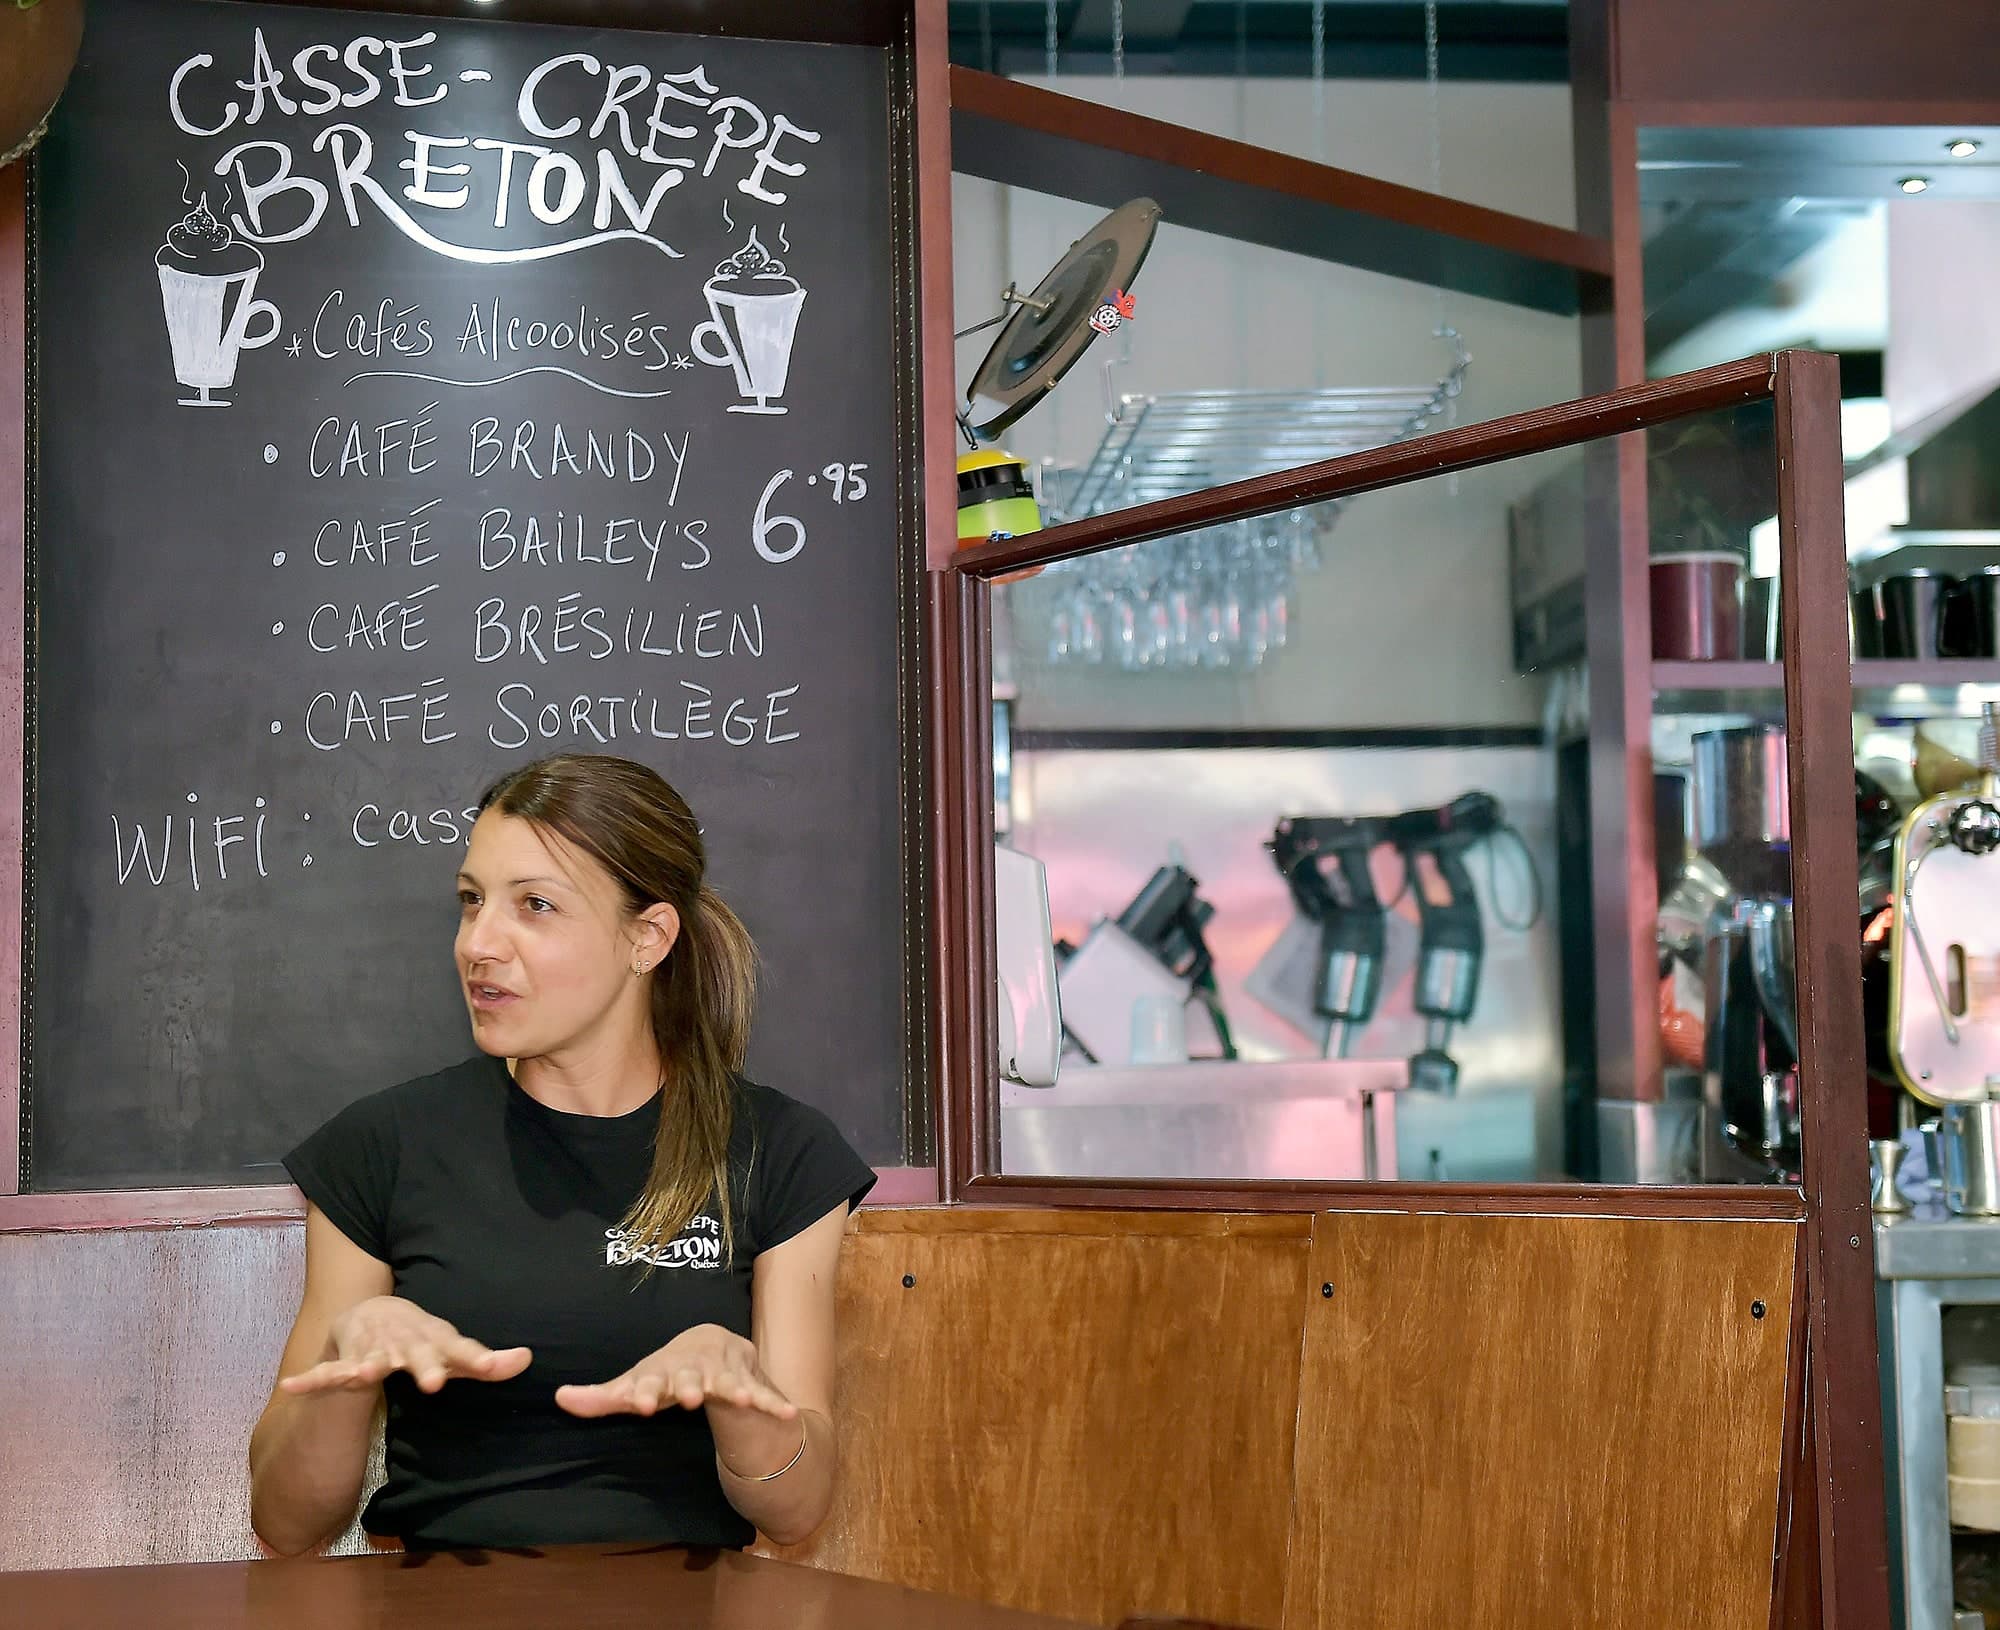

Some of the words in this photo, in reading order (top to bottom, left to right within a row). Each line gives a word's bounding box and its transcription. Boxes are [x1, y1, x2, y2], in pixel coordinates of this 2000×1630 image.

[214, 121, 686, 264] BRETON
[312, 289, 433, 359] Cafés
[456, 297, 672, 371] Alcoolisés
[308, 400, 440, 479] CAFÉ
[468, 415, 691, 507] BRANDY
[313, 498, 443, 567] CAFÉ
[307, 584, 440, 653] CAFÉ
[305, 678, 457, 751] CAFÉ
